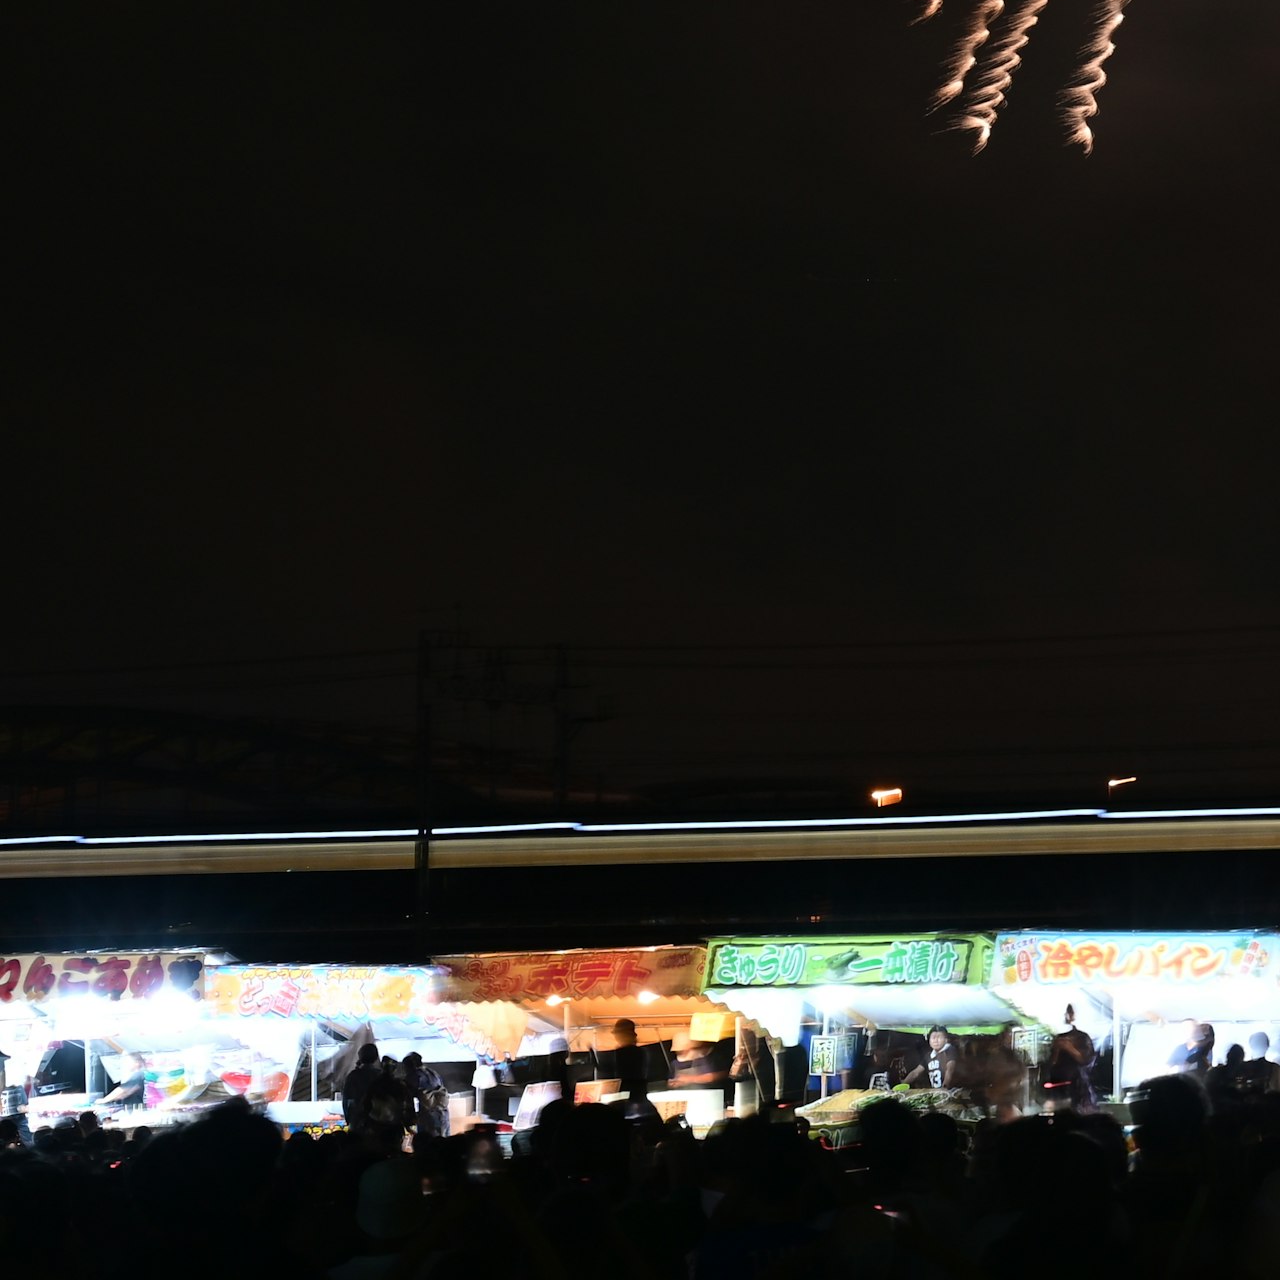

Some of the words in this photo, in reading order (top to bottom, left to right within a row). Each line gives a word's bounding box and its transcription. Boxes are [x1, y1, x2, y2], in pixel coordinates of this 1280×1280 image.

[522, 961, 652, 996] ポテト
[715, 944, 806, 984] きゅうり
[849, 940, 957, 983] 一本漬け
[1037, 939, 1224, 980] 冷やしパイン
